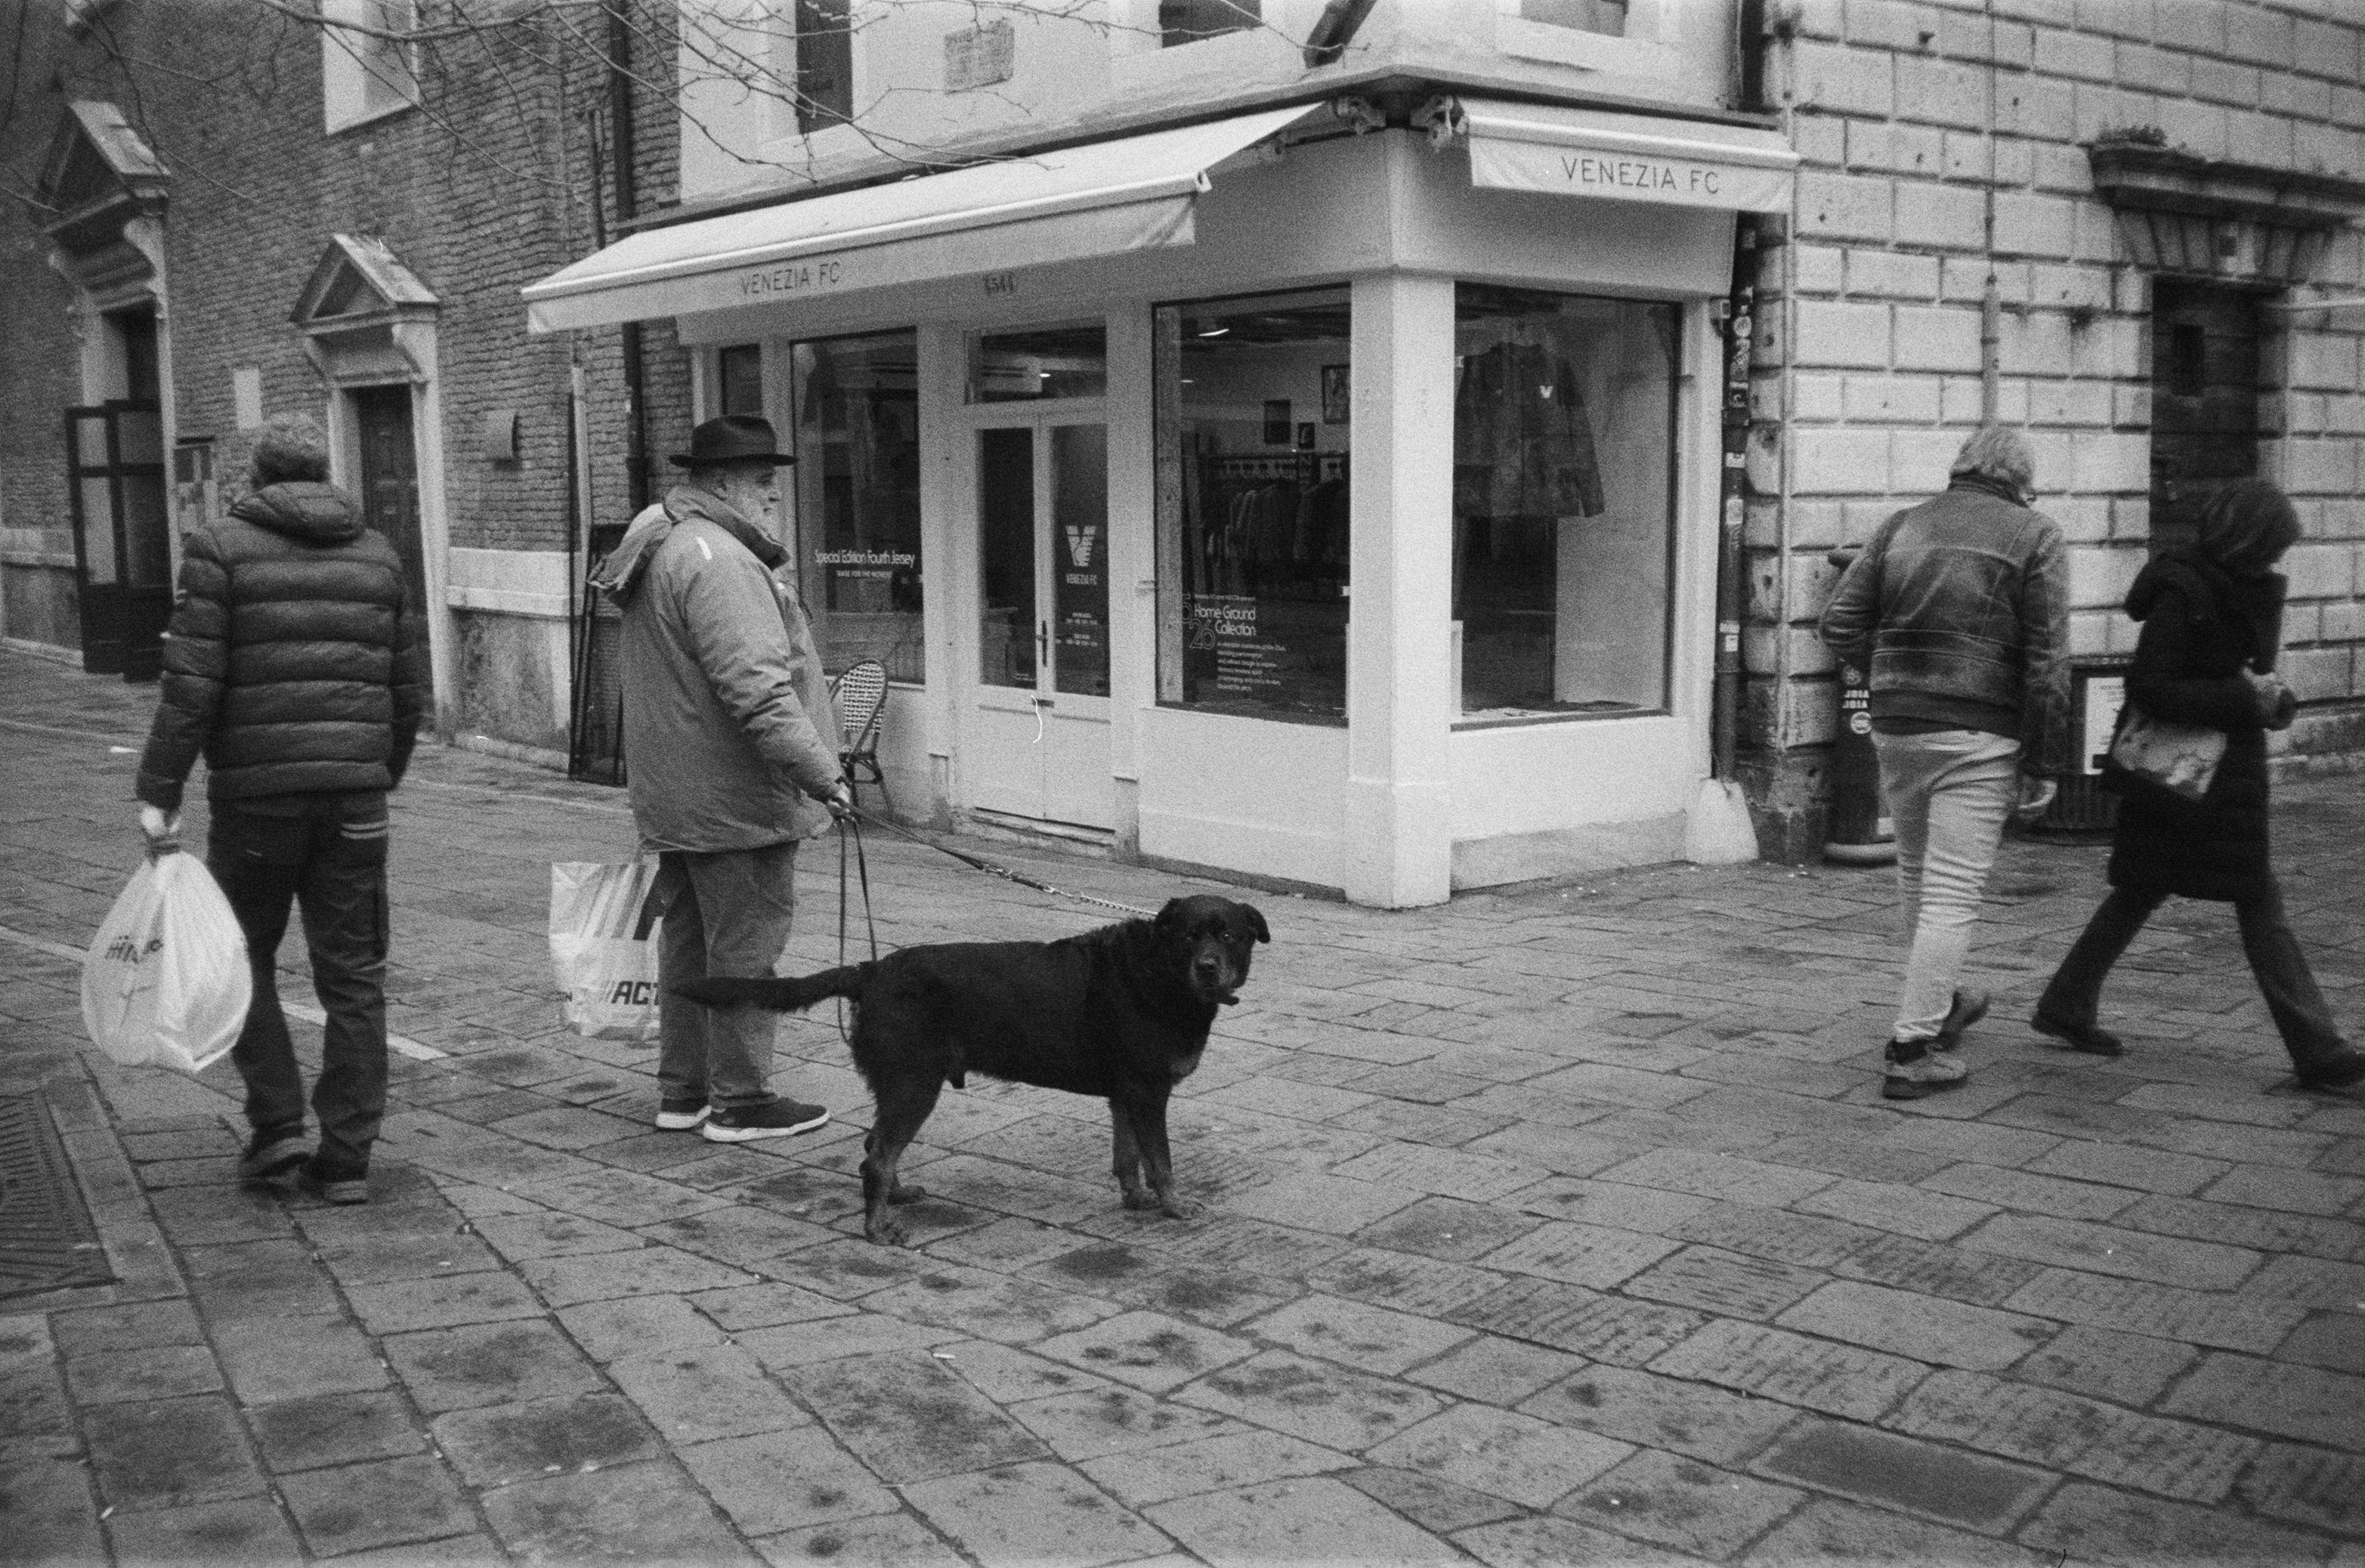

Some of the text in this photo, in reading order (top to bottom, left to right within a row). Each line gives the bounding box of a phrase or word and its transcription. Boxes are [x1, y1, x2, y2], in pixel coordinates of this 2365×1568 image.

[1561, 156, 1720, 195] VENEZIA FC
[740, 261, 840, 295] VENEZIA FC
[842, 549, 866, 564] Edition
[867, 549, 891, 565] Fourth
[891, 550, 915, 568] Jersey
[1195, 604, 1256, 620] Home Ground
[1215, 620, 1257, 636] Collection
